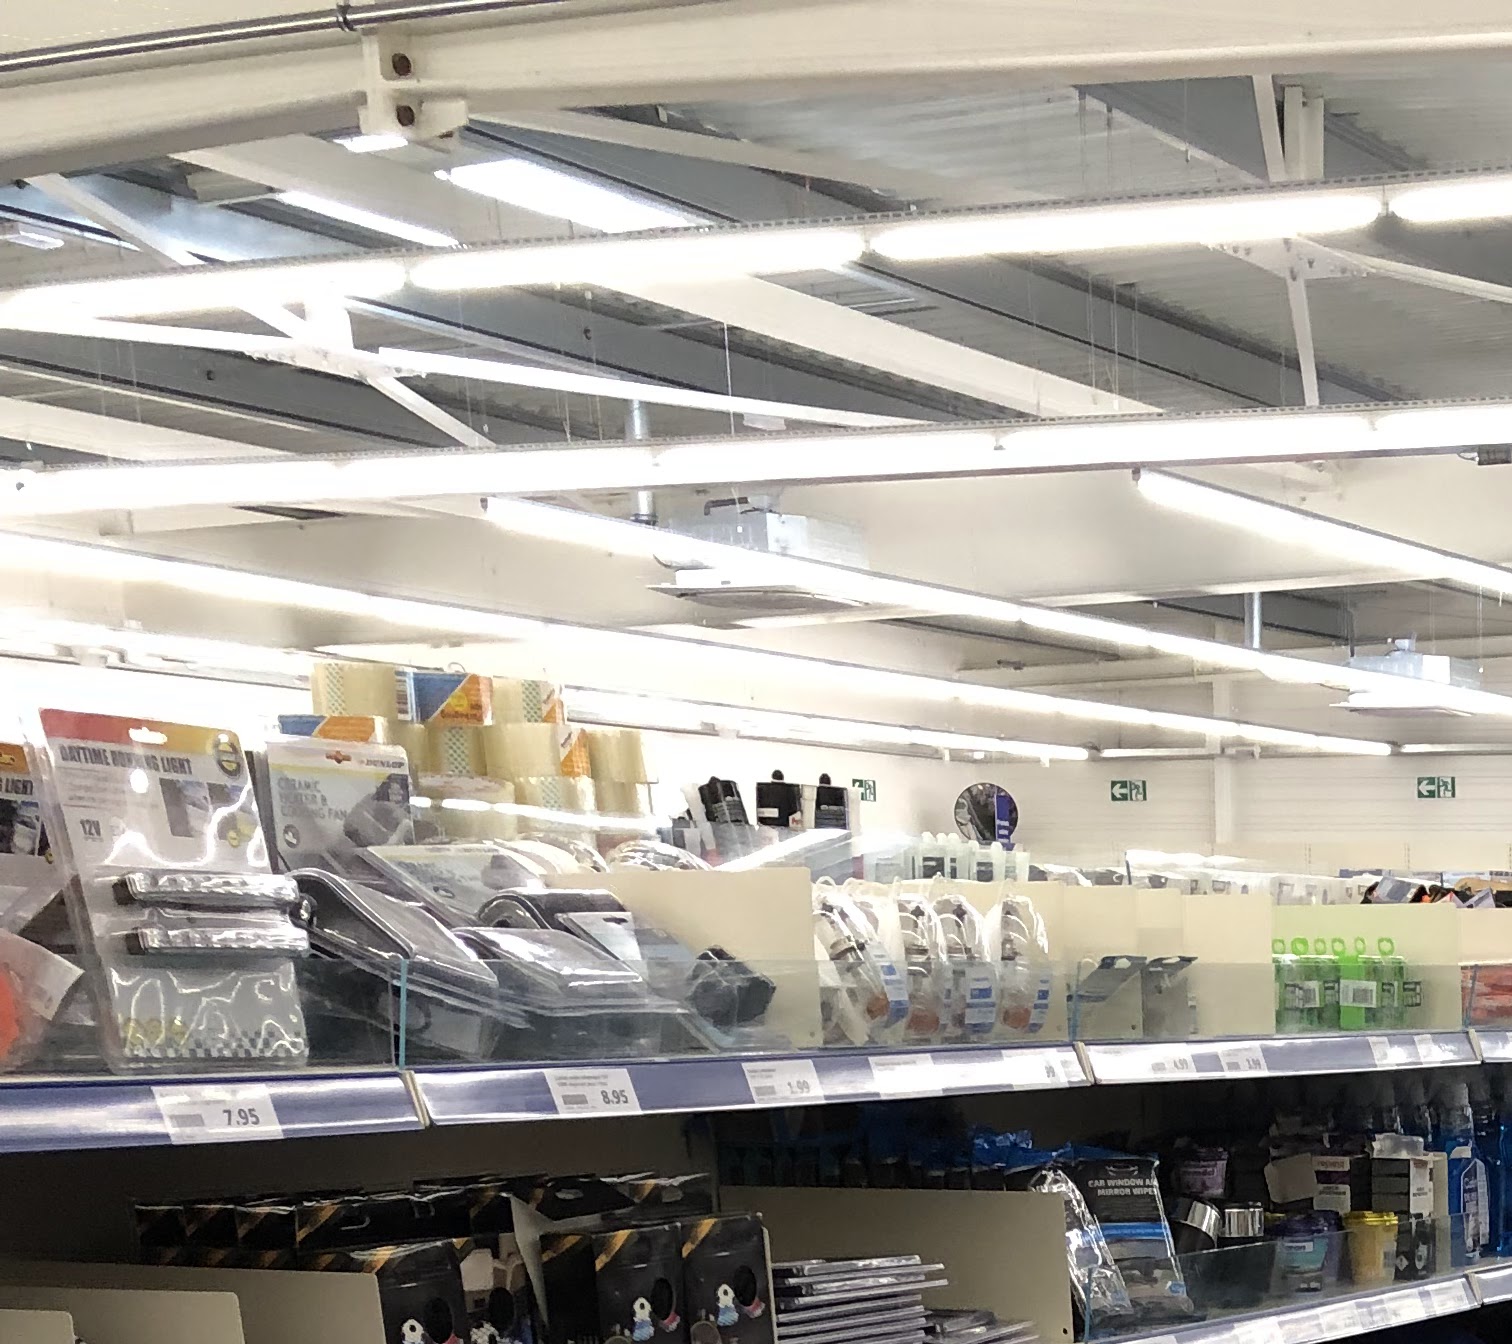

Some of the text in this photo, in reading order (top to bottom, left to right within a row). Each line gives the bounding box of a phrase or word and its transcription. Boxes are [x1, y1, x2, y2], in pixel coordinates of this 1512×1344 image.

[161, 757, 193, 775] LIGHT
[4, 779, 34, 796] LIGHT
[328, 808, 348, 821] FAN
[80, 818, 102, 838] 12V
[787, 1080, 811, 1095] 1.99
[601, 1089, 628, 1105] 8.95
[222, 1108, 260, 1127] 7.95
[1088, 1178, 1106, 1188] CAR
[1108, 1177, 1142, 1188] WINDOW
[1097, 1187, 1132, 1197] MIRROR
